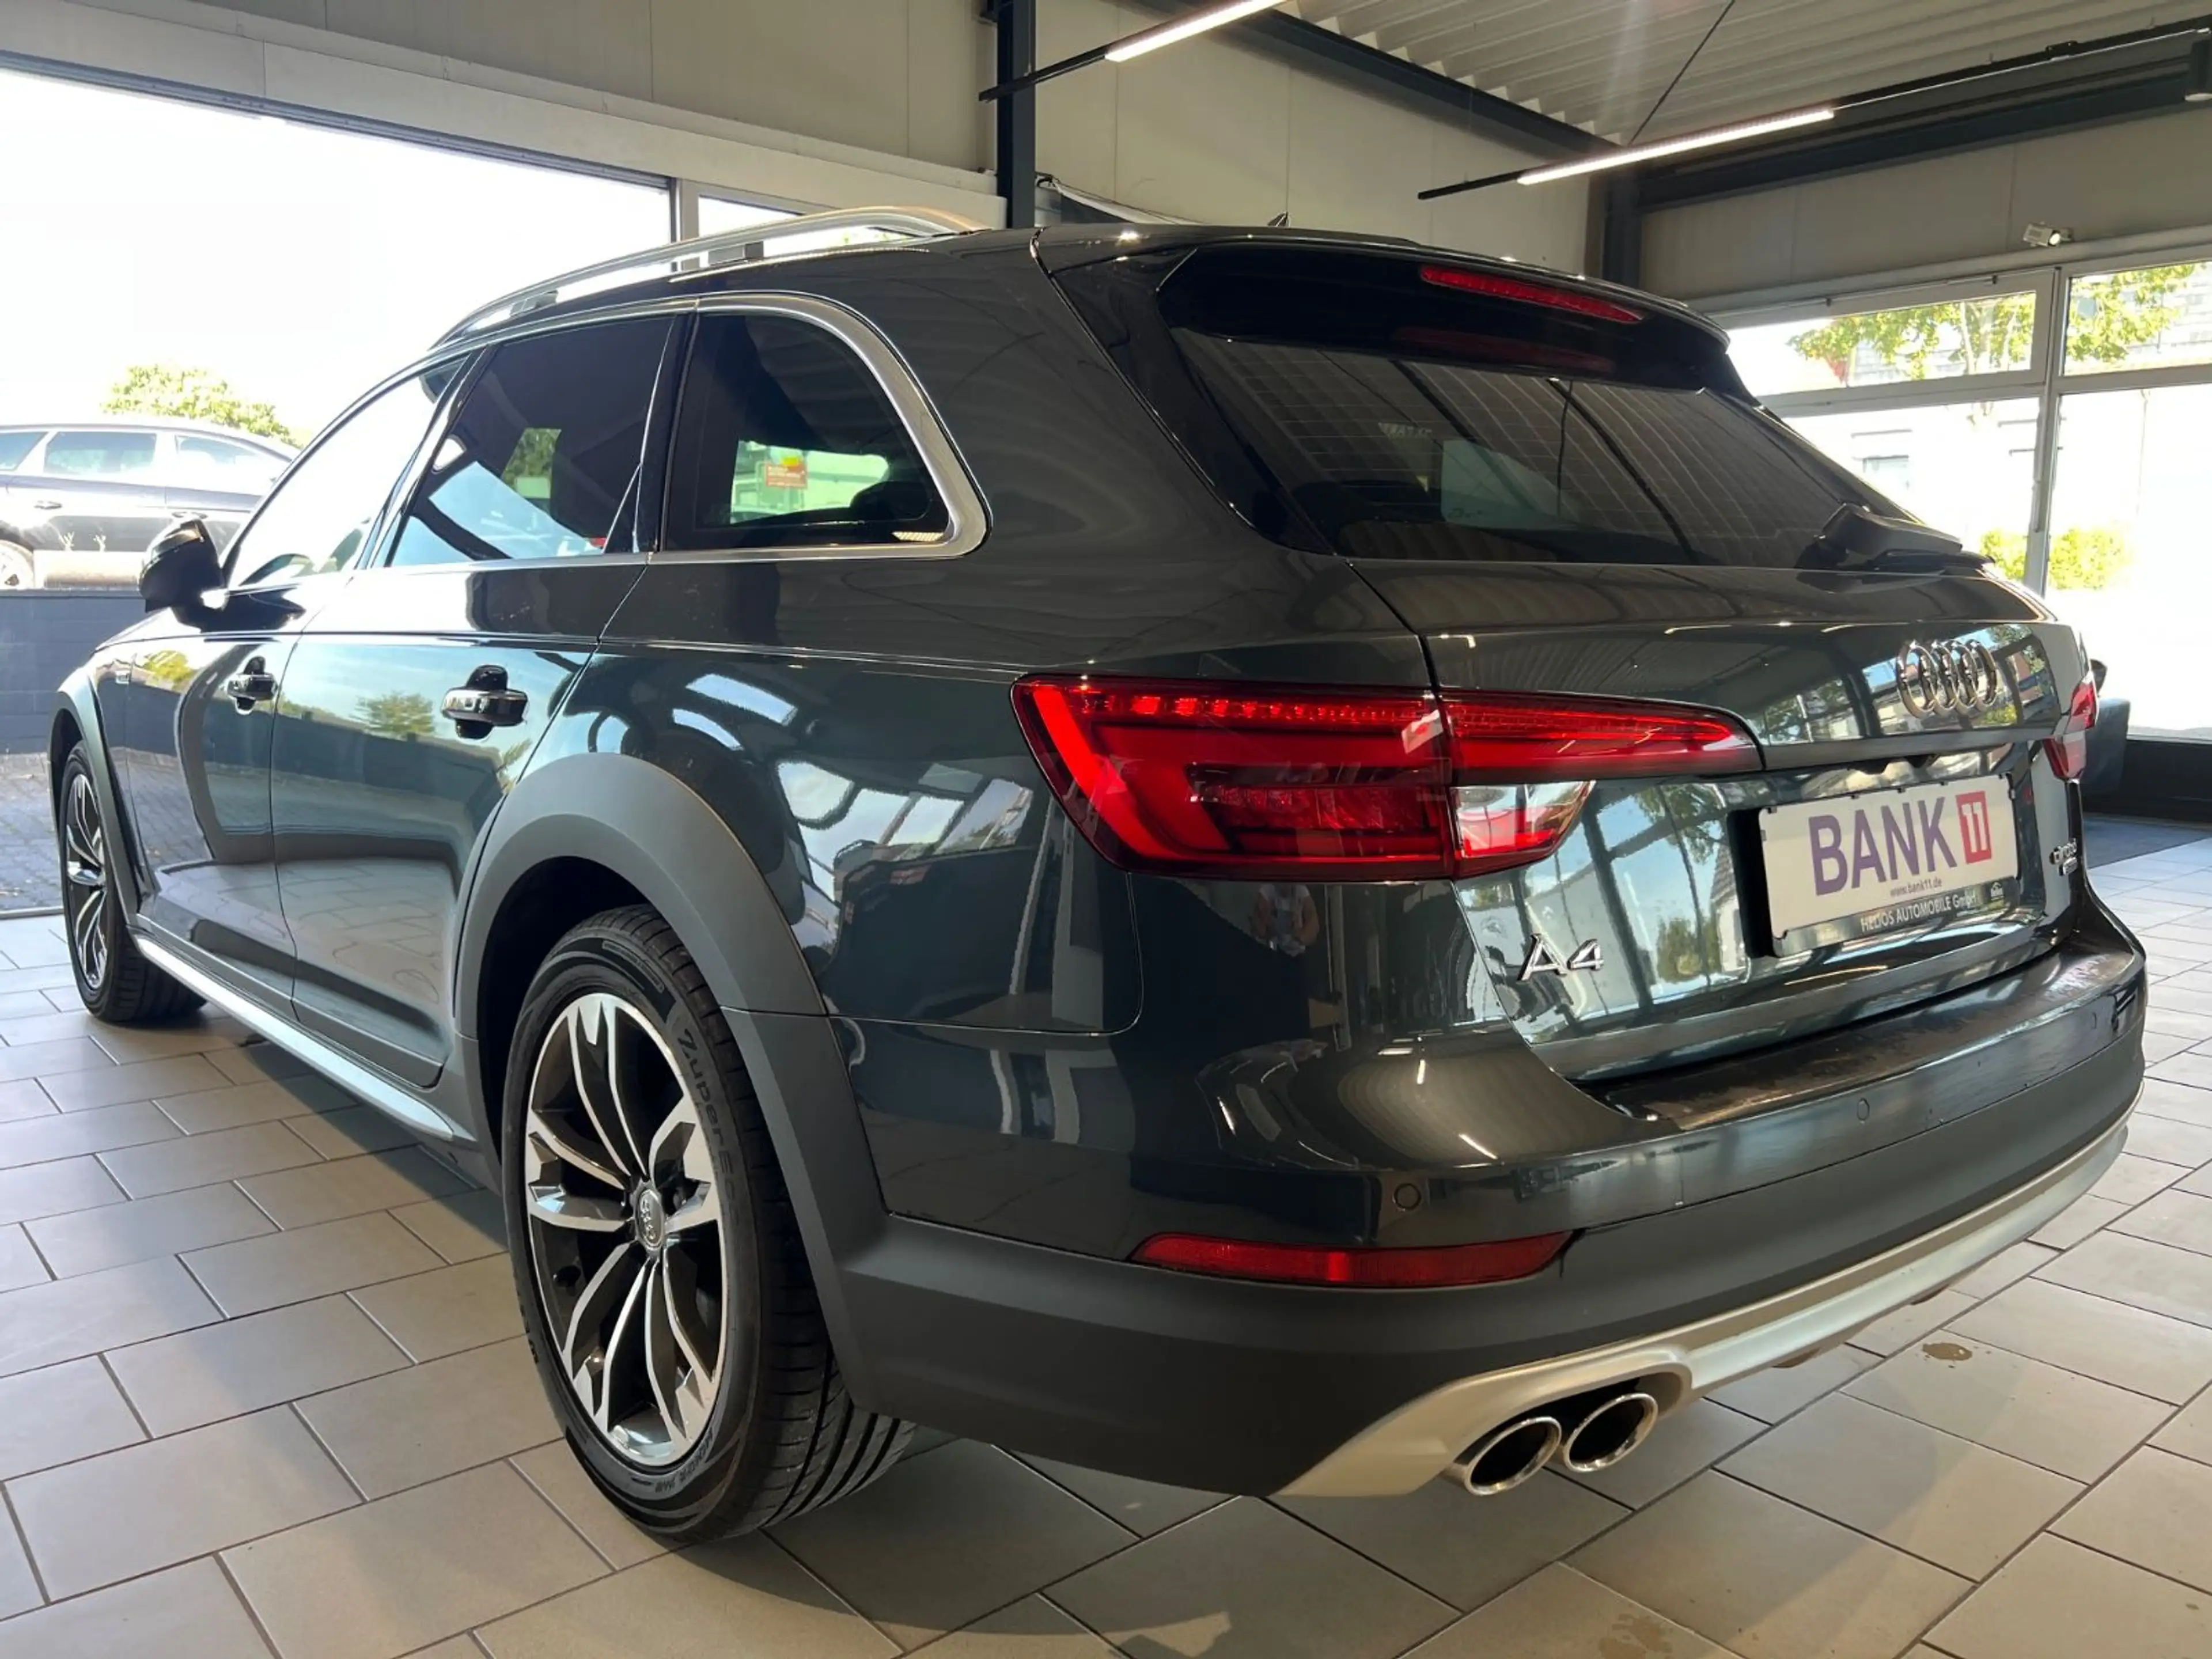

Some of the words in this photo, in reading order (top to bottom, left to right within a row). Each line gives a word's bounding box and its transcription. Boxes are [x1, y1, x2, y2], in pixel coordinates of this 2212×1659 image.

[1808, 797, 1957, 896] BANK
[1961, 801, 1987, 853] 11
[1896, 896, 1951, 923] AUTOMOBILE
[1953, 888, 1976, 909] GmbH
[1517, 933, 1604, 982] A4
